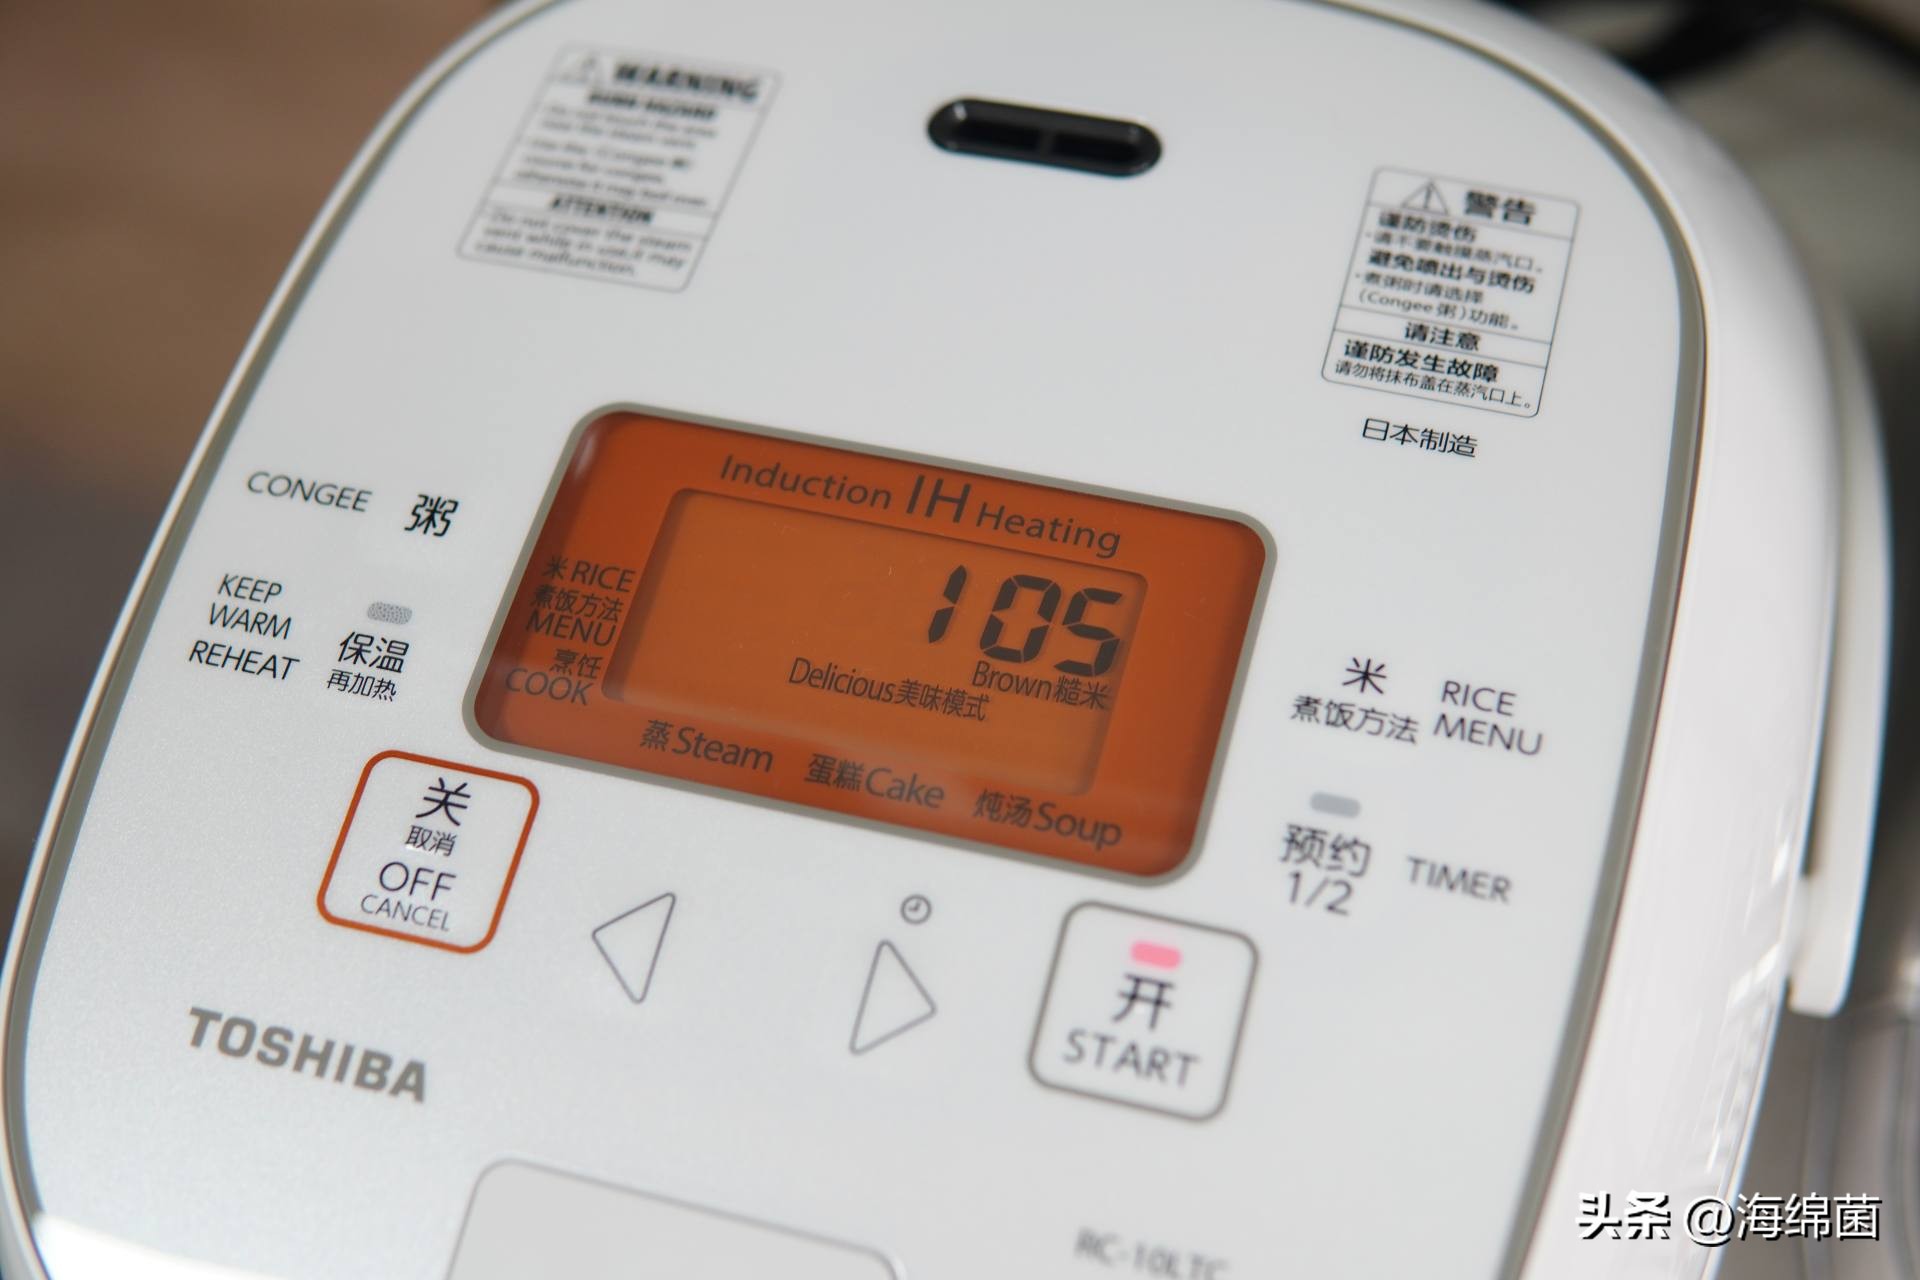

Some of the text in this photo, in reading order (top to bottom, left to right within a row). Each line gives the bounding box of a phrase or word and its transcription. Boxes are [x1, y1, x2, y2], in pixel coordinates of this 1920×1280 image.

[612, 61, 761, 102] WARNING
[549, 193, 655, 225] ATTENTION
[1464, 190, 1537, 225] 警告
[1368, 248, 1537, 294] 避免喷出与烫伤
[1404, 321, 1482, 352] 请注意
[1343, 338, 1500, 382] 谨防发生故障
[1334, 359, 1531, 410] 请勿将抹布盖在蒸汽口上。
[1361, 417, 1479, 458] 日本制造
[246, 470, 460, 538] CONGEE 粥
[719, 454, 1122, 560] Induction IH Heating
[217, 573, 283, 604] KEEP
[542, 555, 636, 594] 米 RICE
[207, 601, 292, 640] WARM
[529, 582, 624, 623] 煮饭方法
[927, 563, 1124, 678] 105
[525, 608, 618, 649] MENU
[188, 639, 301, 680] REHEAT
[336, 630, 411, 674] 保温
[550, 648, 604, 681] 烹饪
[325, 668, 398, 703] 再加热
[504, 667, 594, 706] COOK
[1343, 656, 1388, 695] 米
[1441, 679, 1519, 718] RICE
[1289, 693, 1420, 746] 煮饭方法
[1433, 711, 1545, 757] MENU
[416, 776, 472, 827] 关
[404, 824, 457, 858] 取消
[1278, 822, 1372, 879] 预约
[378, 860, 457, 901] OFF
[1286, 871, 1355, 918] 1/2
[1405, 854, 1514, 904] TIMER
[360, 893, 451, 933] CANCEL
[1111, 971, 1177, 1032] 开
[189, 1006, 426, 1104] TOSHIBA
[1062, 1028, 1201, 1089] START
